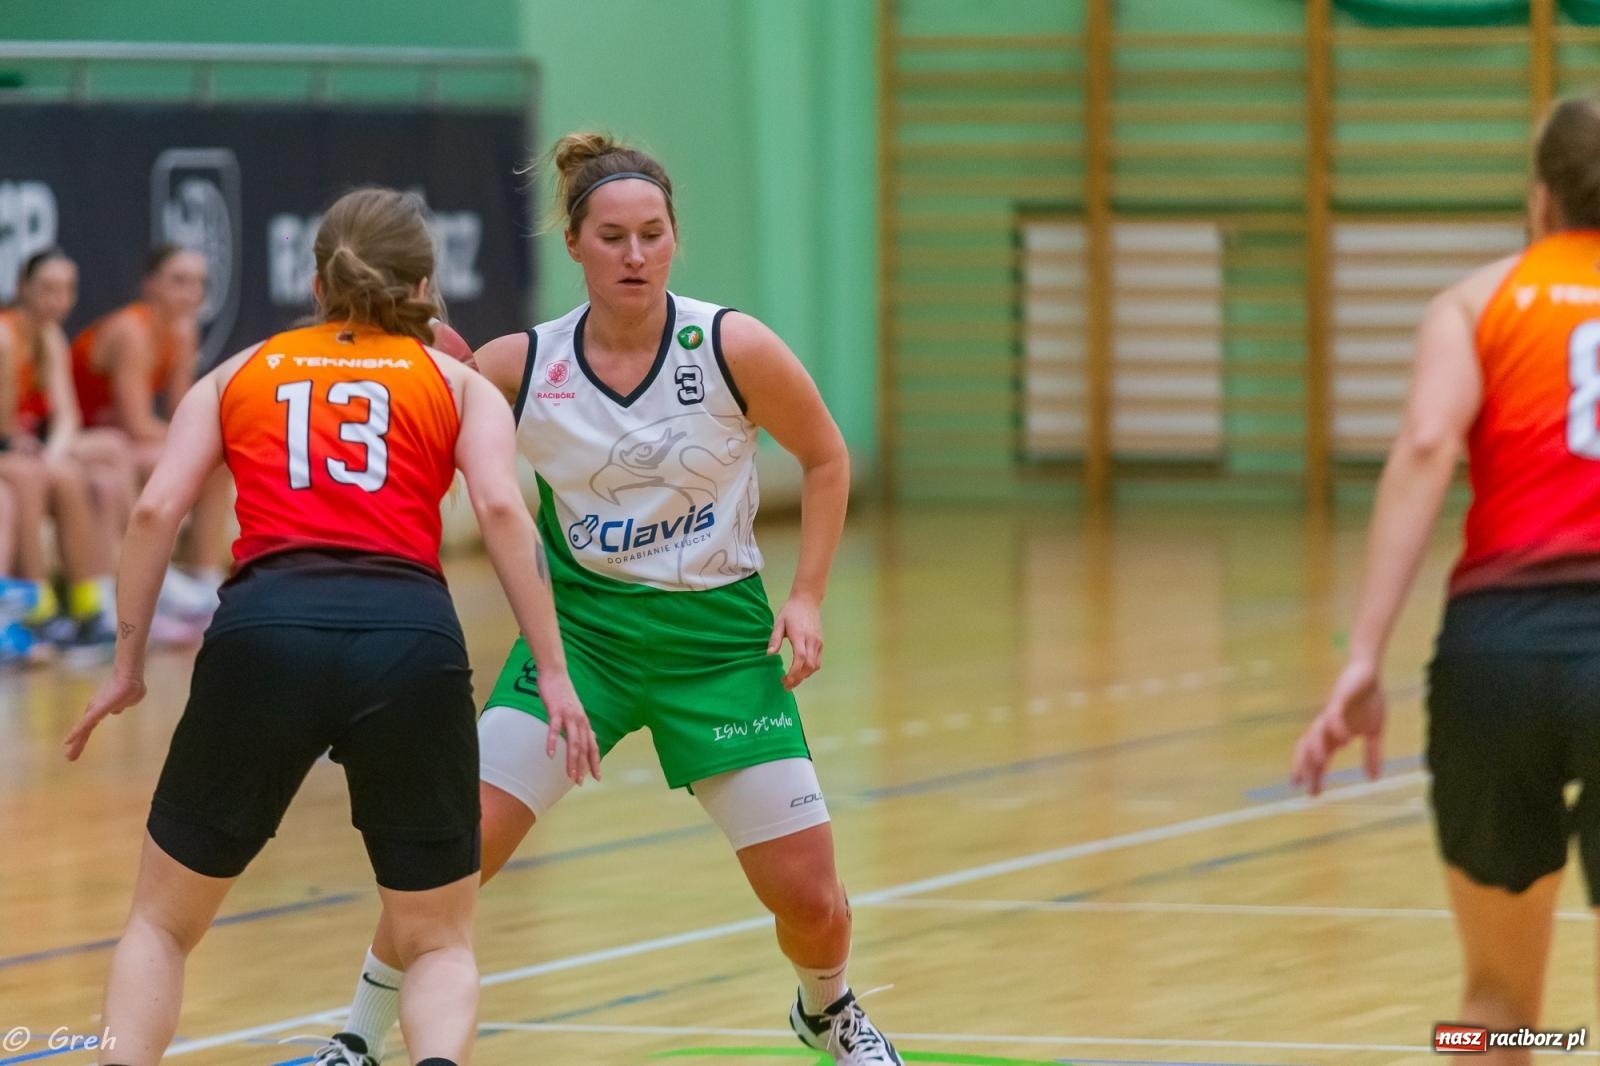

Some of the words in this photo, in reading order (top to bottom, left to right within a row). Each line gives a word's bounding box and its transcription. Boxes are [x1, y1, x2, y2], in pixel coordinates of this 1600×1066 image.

[536, 391, 577, 400] RACIBÓRZ
[675, 364, 705, 406] 3
[275, 379, 391, 493] 13
[599, 502, 716, 553] Clavis
[607, 544, 671, 564] DORABIANIE
[712, 721, 748, 741] ISW
